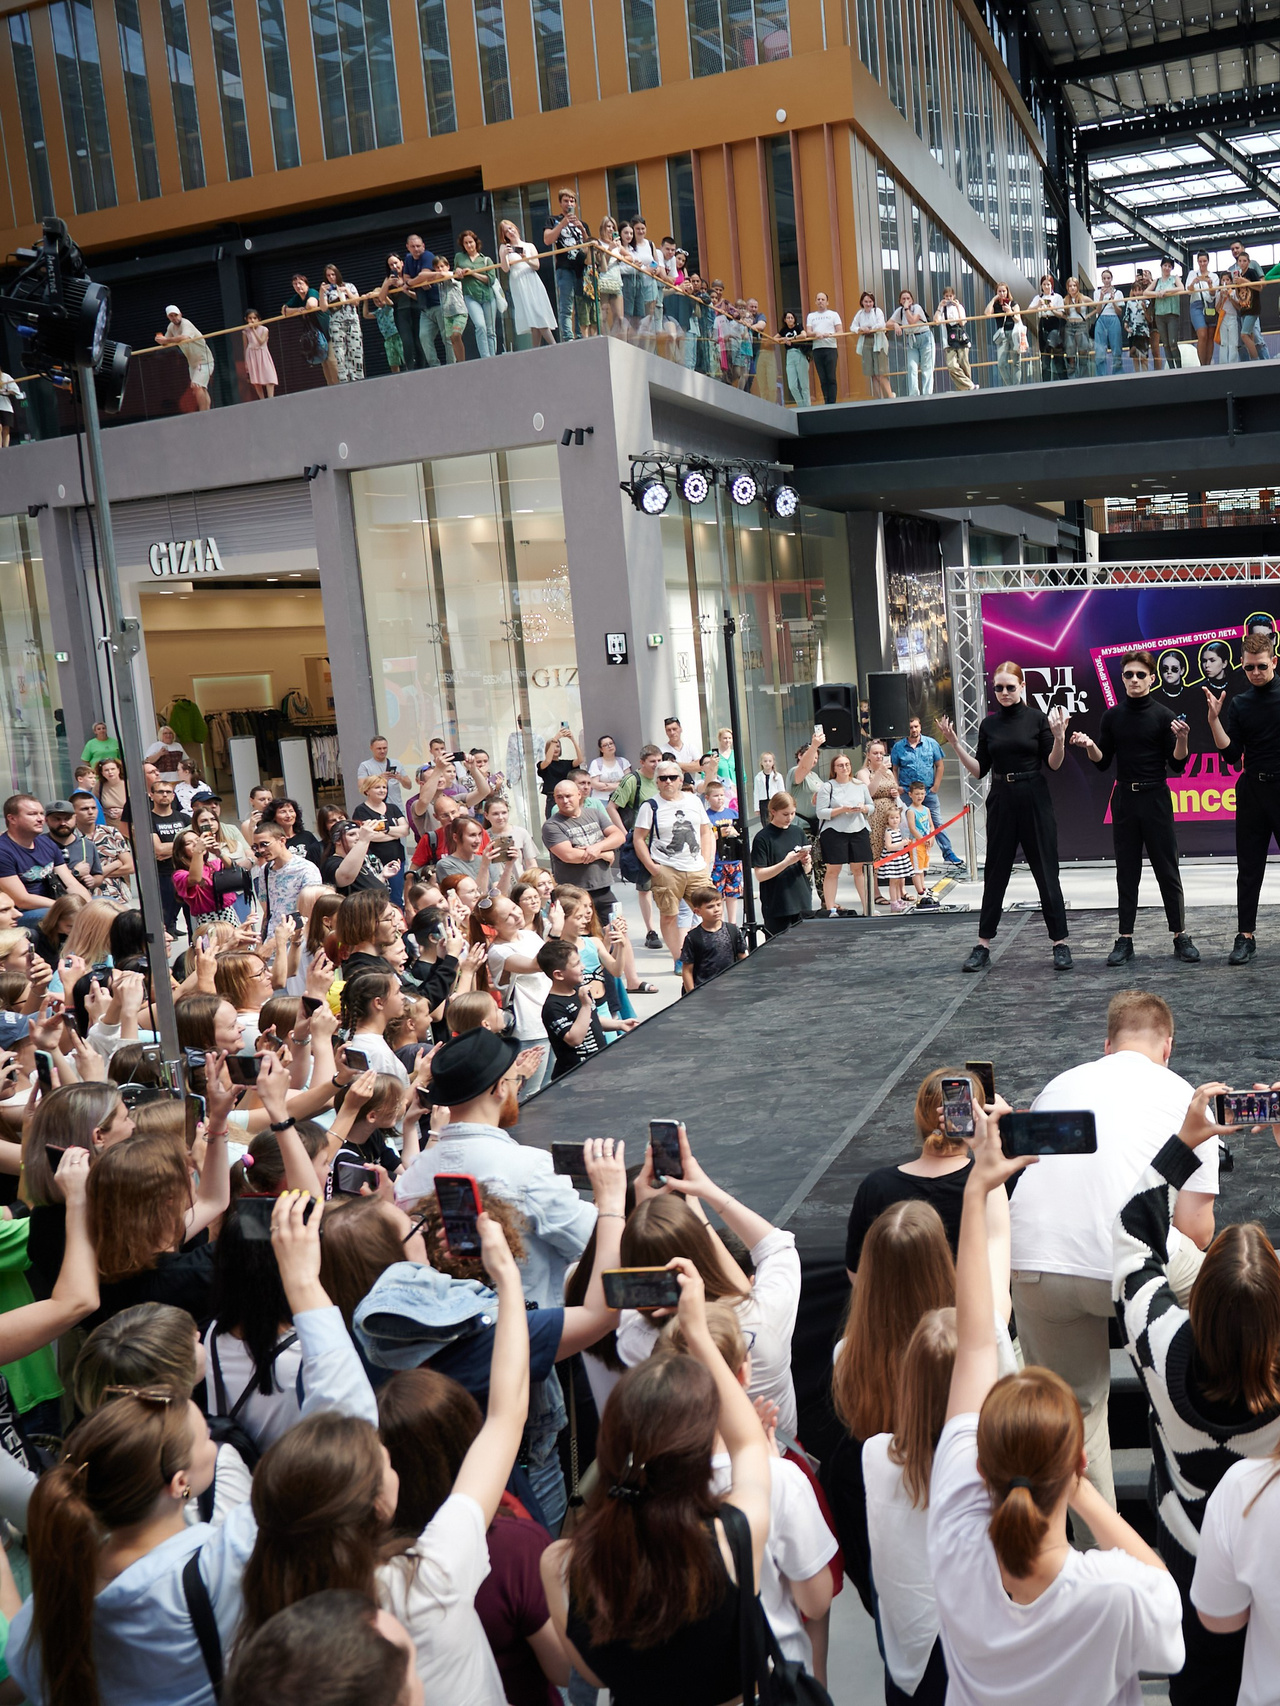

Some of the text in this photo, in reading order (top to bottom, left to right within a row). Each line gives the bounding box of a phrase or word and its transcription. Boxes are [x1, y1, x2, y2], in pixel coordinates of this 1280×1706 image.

[148, 537, 225, 576] GIZIA
[1101, 629, 1237, 656] МУЗЫКАЛЬНОЕ СОБЫТИЕ ЭТОГО ЛЕТА
[1102, 681, 1115, 707] САМОЕ
